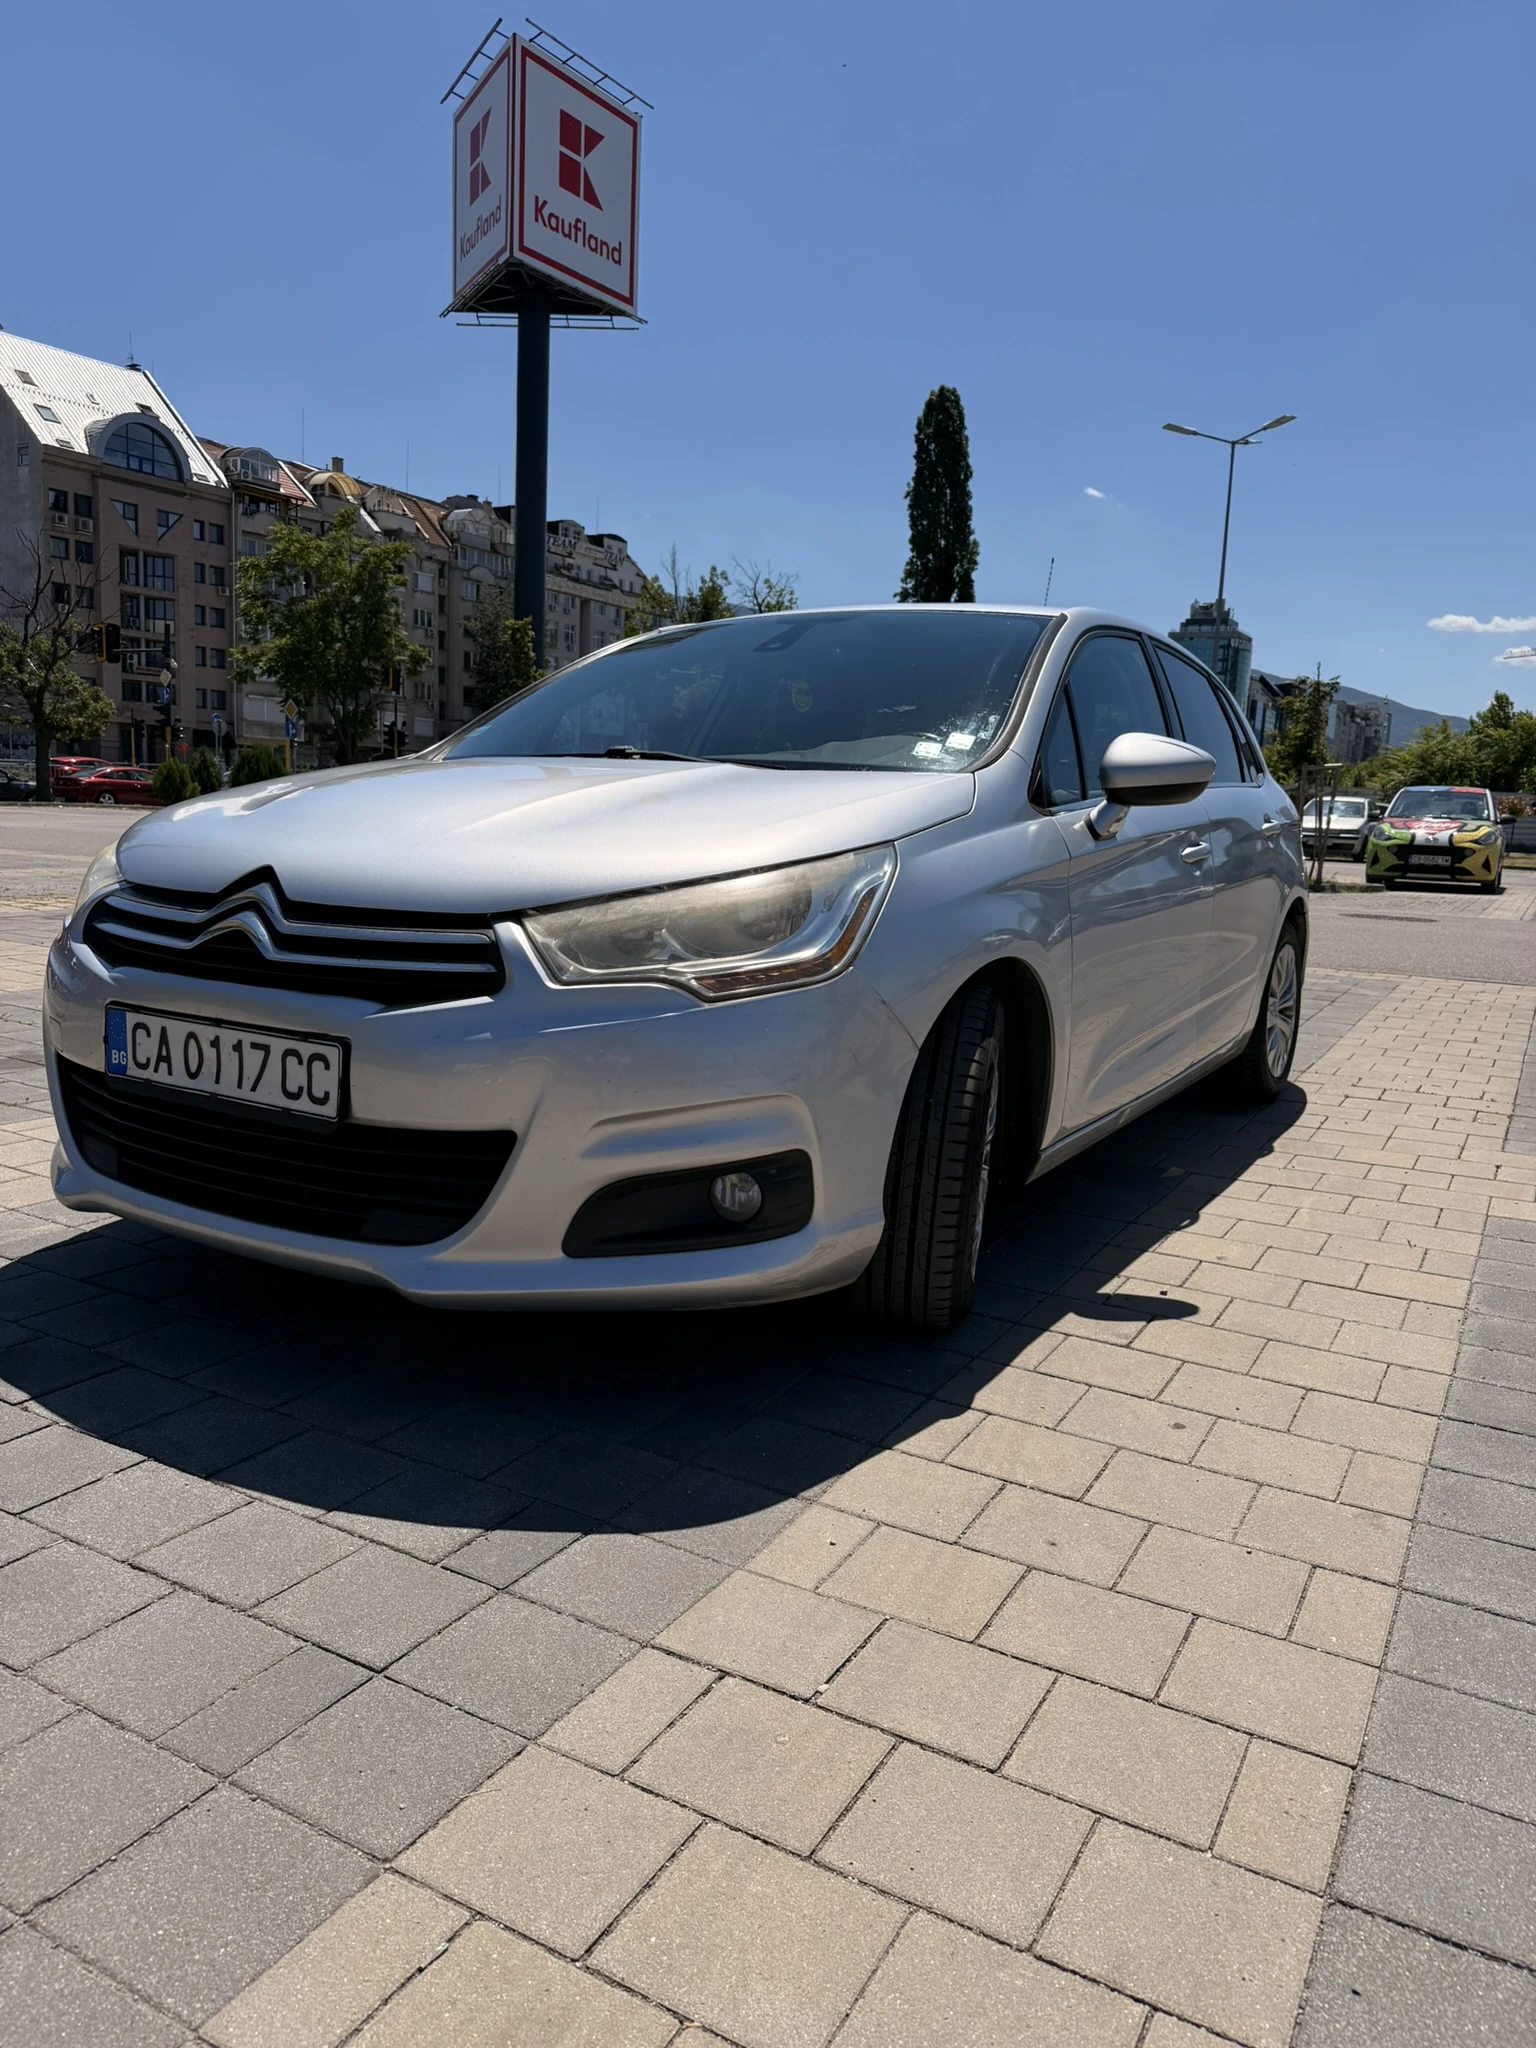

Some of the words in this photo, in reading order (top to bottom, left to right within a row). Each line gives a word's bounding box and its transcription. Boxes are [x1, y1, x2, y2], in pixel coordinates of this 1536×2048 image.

[460, 194, 502, 262] Kaufland
[533, 194, 622, 267] Kaufland
[546, 535, 578, 551] TEAM
[603, 550, 625, 564] TEAM
[111, 1049, 127, 1065] BG
[131, 1021, 173, 1076] CA
[183, 1031, 271, 1092] 0117
[281, 1048, 331, 1106] CC
